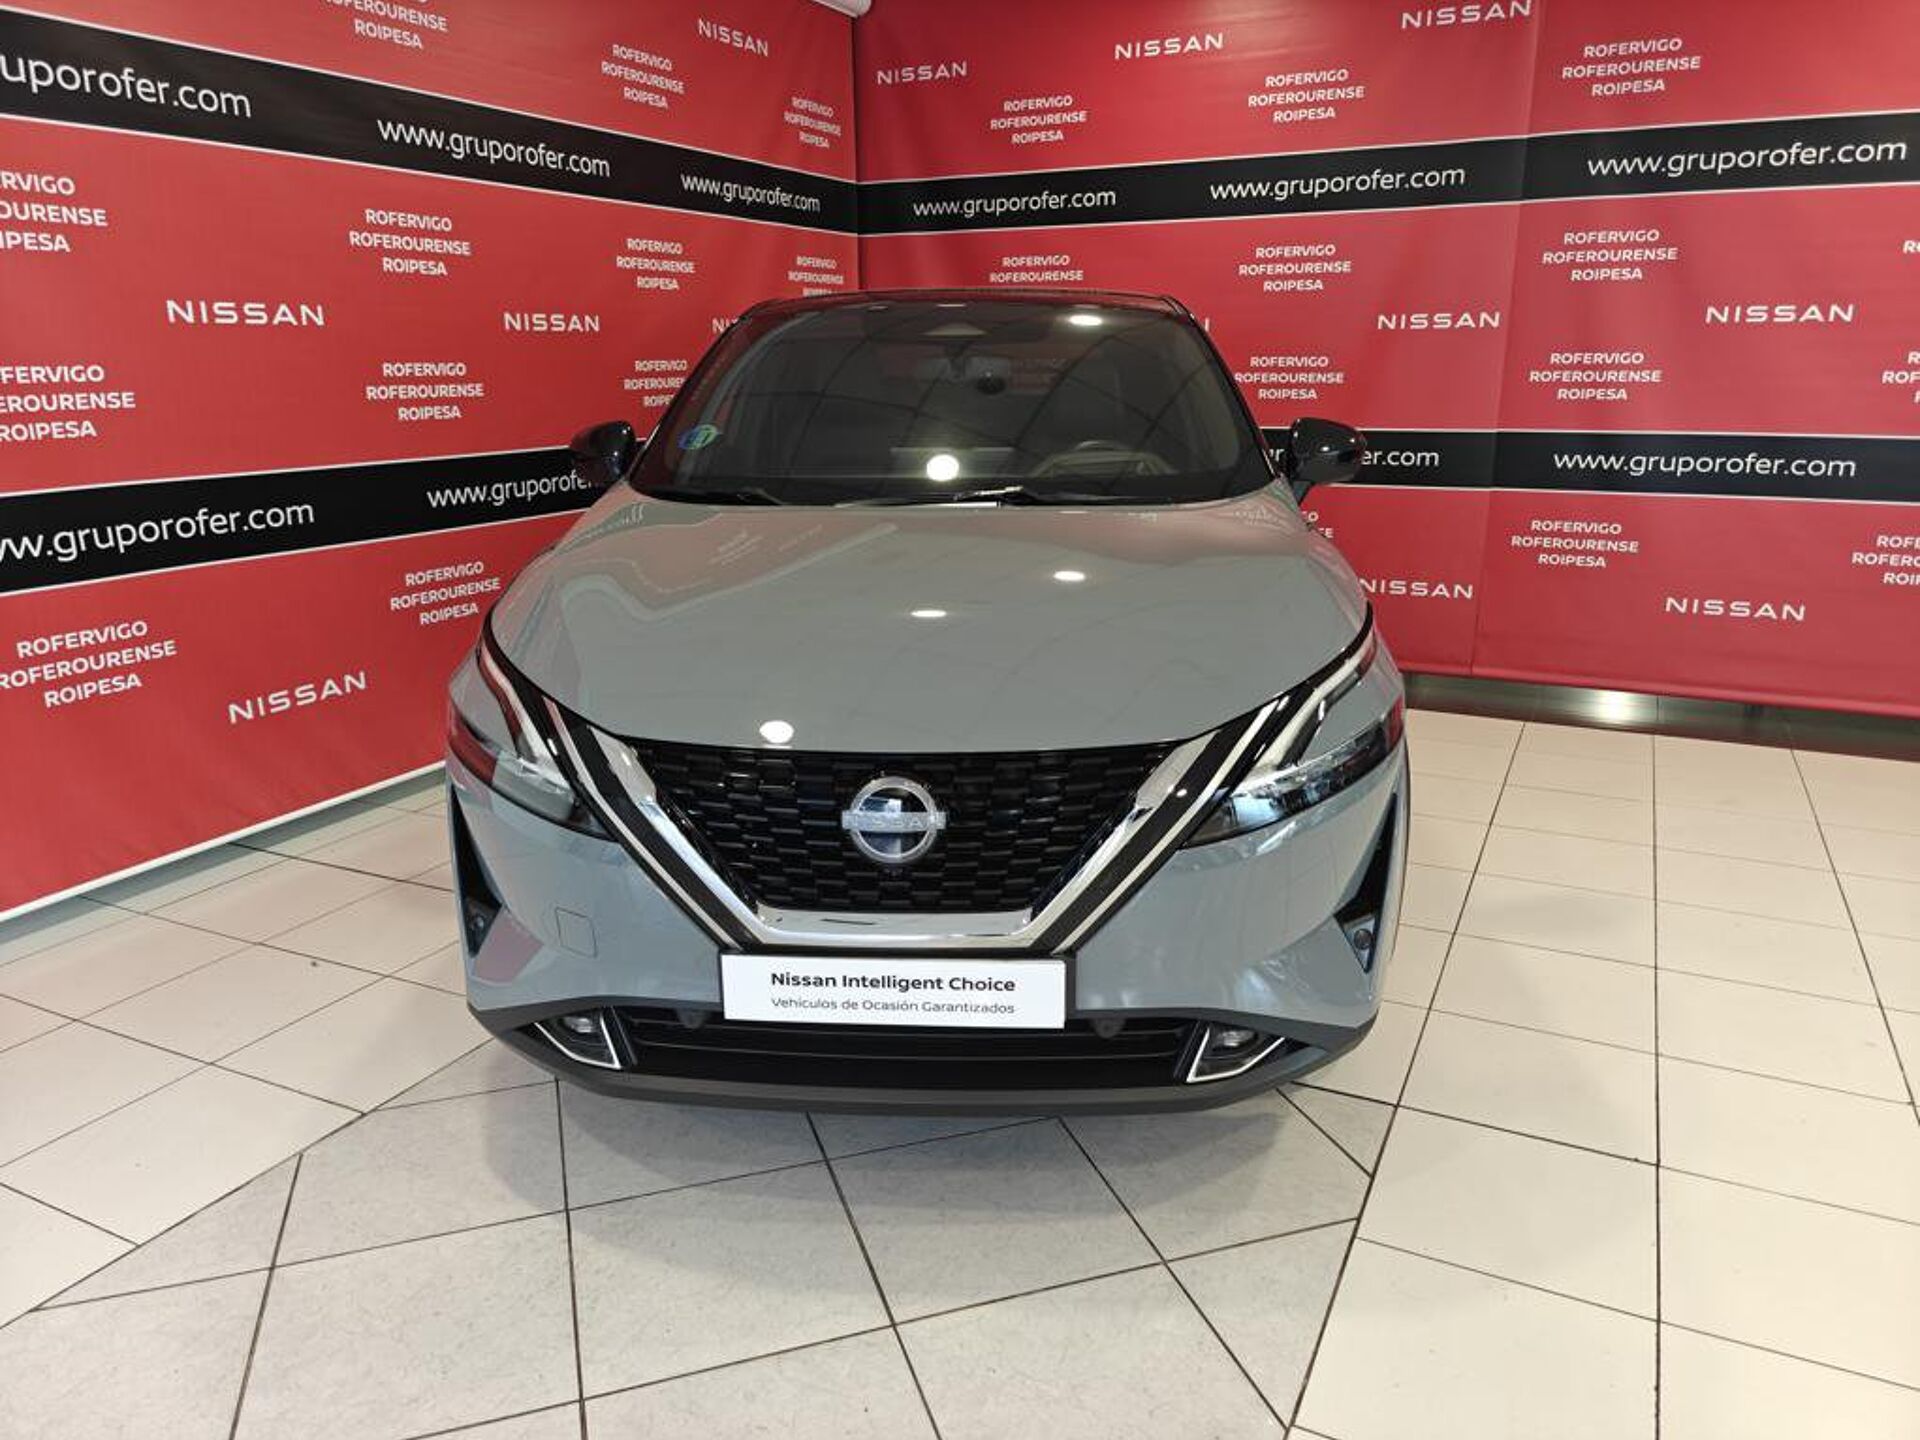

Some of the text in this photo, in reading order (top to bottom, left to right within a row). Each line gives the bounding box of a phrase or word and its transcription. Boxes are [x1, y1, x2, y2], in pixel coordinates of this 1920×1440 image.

[1402, 0, 1531, 29] NISSAN
[355, 19, 422, 48] ROIPESA
[698, 19, 768, 56] NISSAN
[1115, 32, 1223, 59] NISSAN
[1584, 38, 1682, 57] ROFERVIGO
[877, 62, 966, 84] NISSAN
[1562, 56, 1700, 78] ROFEROURENSE
[1265, 69, 1348, 87] ROFERVIGO
[1592, 79, 1665, 96] ROIPESA
[1004, 95, 1073, 111] ROFERVIGO
[1248, 86, 1364, 107] ROFEROURENSE
[991, 111, 1087, 129] ROFEROURENSE
[1273, 107, 1335, 122] ROIPESA
[1012, 130, 1064, 143] ROIPESA
[377, 120, 609, 176] www.gruporofer.com
[1588, 142, 1907, 177] www.gruporofer.com
[681, 174, 820, 211] www.gruporofer.com
[1210, 169, 1465, 201] www.gruporofer.com
[913, 191, 1116, 218] www.gruporofer.com
[365, 209, 452, 231] ROFERVIGO
[349, 231, 470, 255] ROFEROURENSE
[1564, 229, 1659, 244] ROFERVIGO
[1256, 244, 1336, 258] ROFERVIGO
[1543, 248, 1677, 263] ROFEROURENSE
[383, 257, 447, 275] ROIPESA
[1003, 255, 1070, 267] ROFERVIGO
[1239, 261, 1351, 275] ROFEROURENSE
[1571, 268, 1642, 281] ROIPESA
[1264, 279, 1323, 291] ROIPESA
[167, 300, 324, 325] NISSAN
[504, 312, 599, 331] NISSAN
[1378, 312, 1500, 329] NISSAN
[1706, 304, 1853, 323] NISSAN
[1251, 356, 1329, 367] ROFERVIGO
[1550, 352, 1644, 364] ROFERVIGO
[382, 363, 466, 376] ROFERVIGO
[1530, 370, 1661, 382] ROFEROURENSE
[366, 384, 483, 400] ROFEROURENSE
[1259, 389, 1317, 399] ROIPESA
[1557, 388, 1627, 400] ROIPESA
[398, 406, 461, 420] ROIPESA
[0, 421, 96, 441] ROIPESA
[1554, 453, 1856, 476] www.gruporofer.com
[1531, 520, 1622, 534] ROFERVIGO
[1512, 536, 1638, 553] ROFEROURENSE
[1538, 554, 1606, 567] ROIPESA
[405, 561, 484, 586] ROFERVIGO
[390, 578, 500, 610] ROFEROURENSE
[1358, 576, 1473, 599] NISSAN
[420, 603, 478, 625] ROIPESA
[1666, 597, 1805, 621] NISSAN
[17, 621, 147, 658] ROFERVIGO
[0, 641, 176, 689] ROFEROURENSE
[44, 674, 142, 707] ROIPESA
[229, 672, 365, 723] NISSAN
[771, 972, 1016, 992] Nissan Intelligent Choice
[841, 998, 859, 1010] de
[862, 999, 919, 1012] Ocasión
[921, 1001, 1015, 1014] Garantizados
